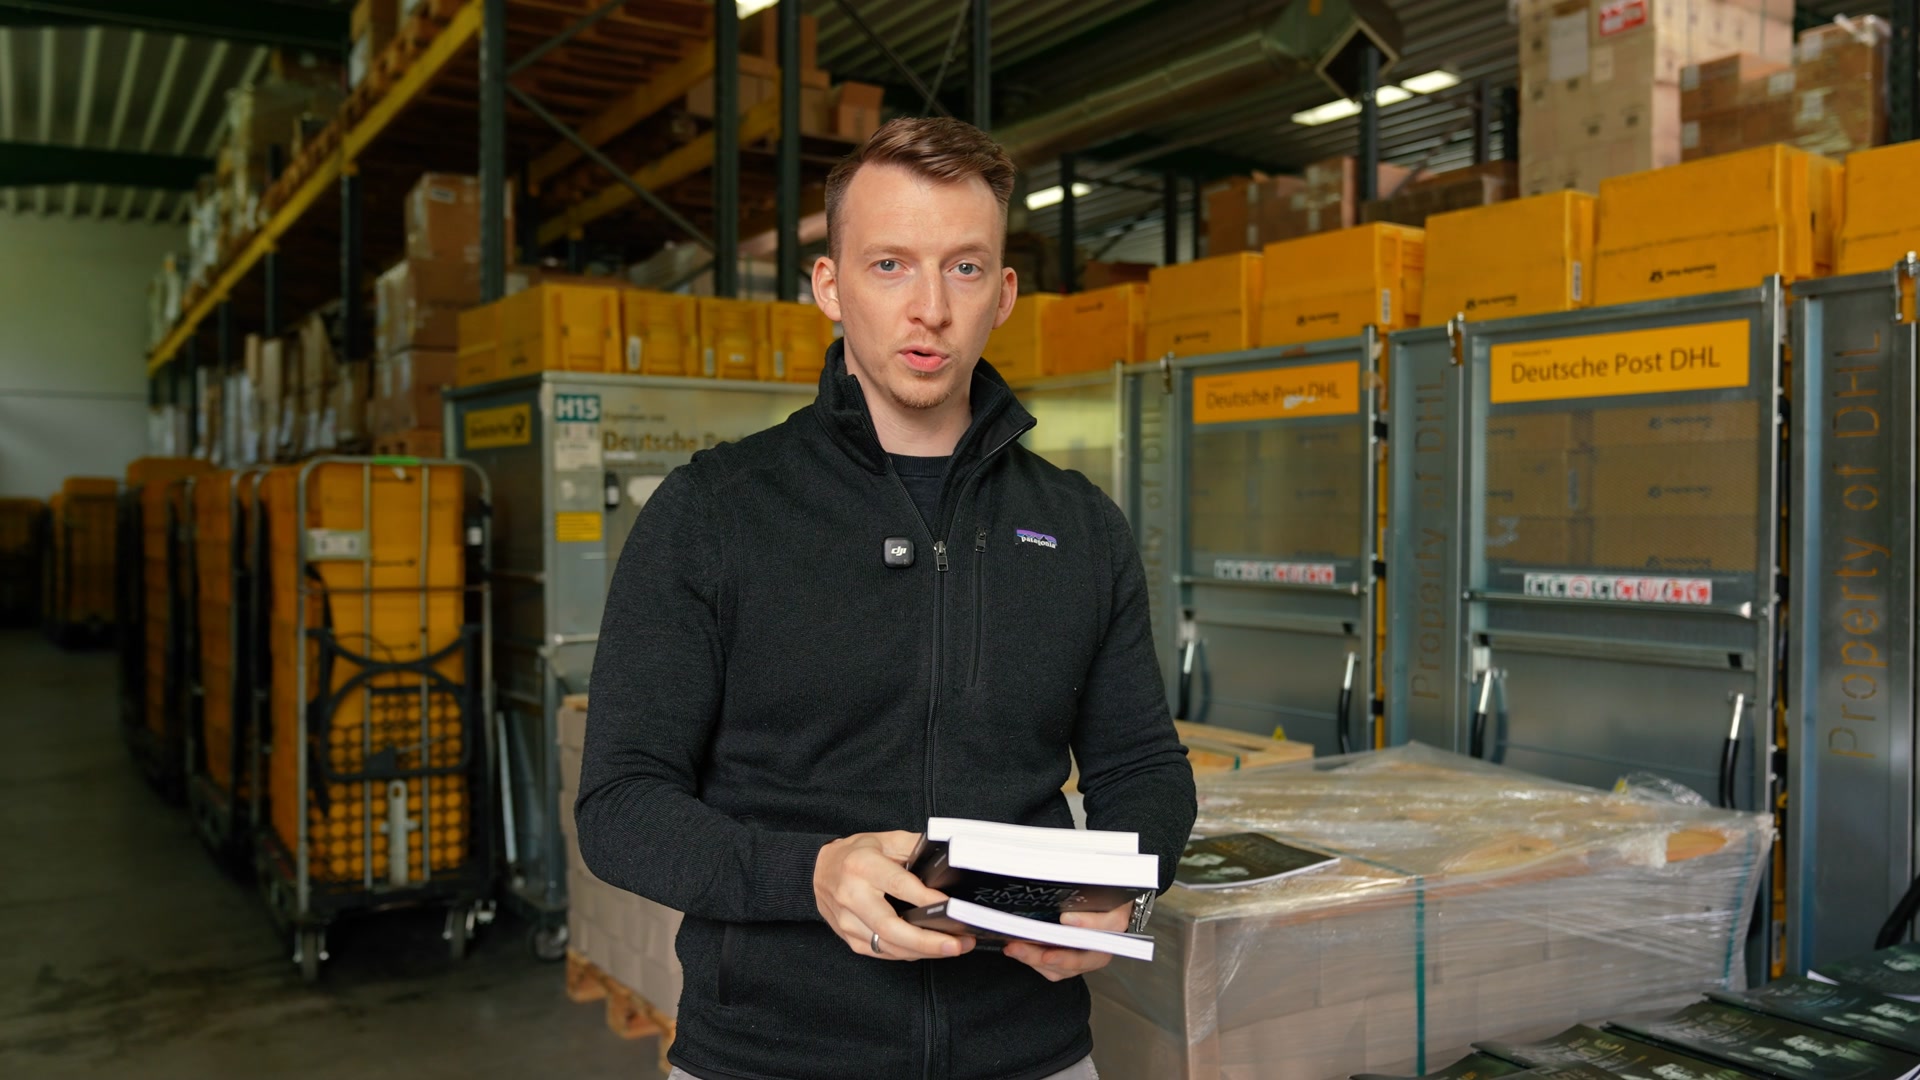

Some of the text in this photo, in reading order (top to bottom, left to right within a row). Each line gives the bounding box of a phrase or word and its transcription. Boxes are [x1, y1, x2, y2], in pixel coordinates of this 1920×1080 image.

[1511, 345, 1721, 384] Deutsche Post DHL
[557, 396, 600, 420] H15
[1206, 387, 1270, 410] Deutsche
[1307, 380, 1341, 399] DHL
[603, 429, 698, 452] Deutsche
[1020, 536, 1057, 549] patagonia
[1412, 369, 1447, 700] Property of DHL
[1828, 329, 1891, 758] Property of DHL
